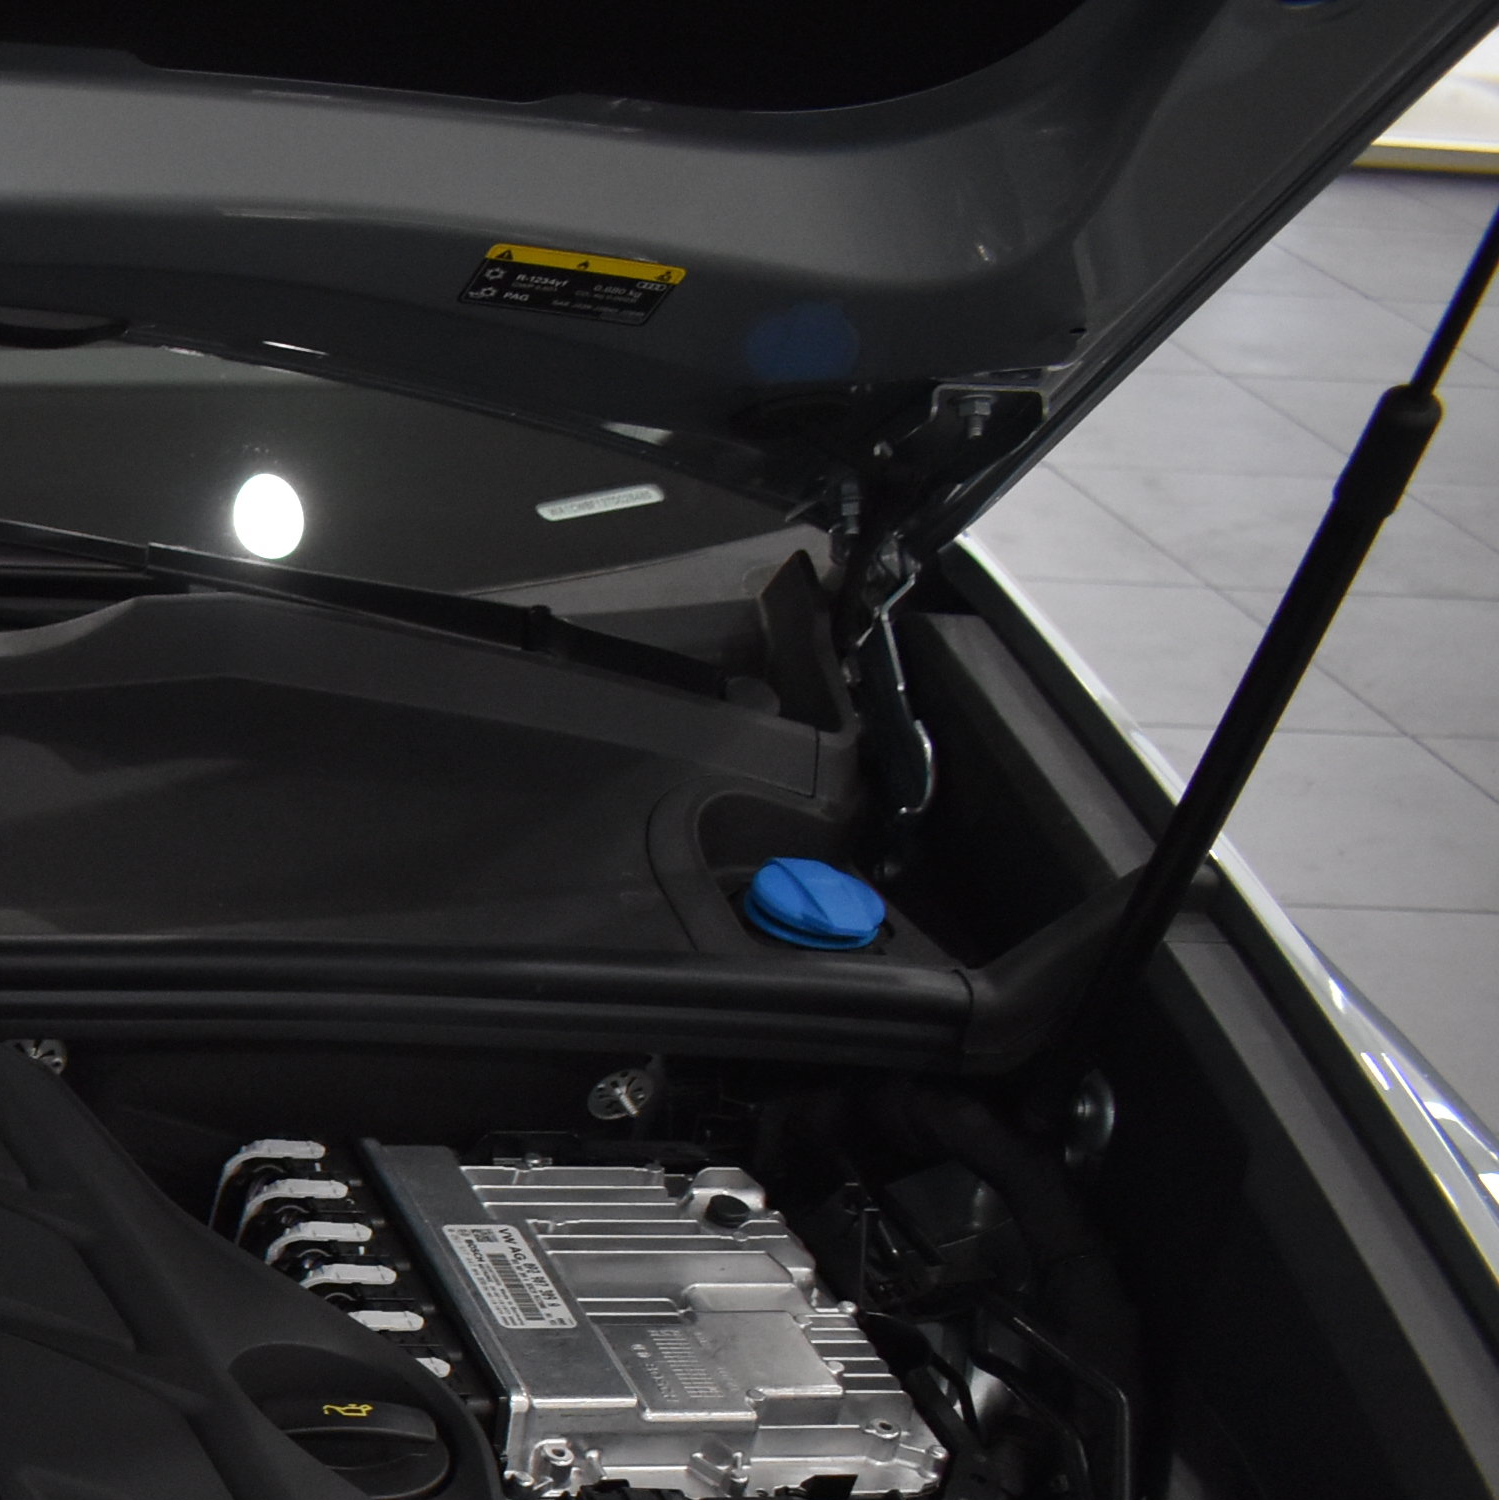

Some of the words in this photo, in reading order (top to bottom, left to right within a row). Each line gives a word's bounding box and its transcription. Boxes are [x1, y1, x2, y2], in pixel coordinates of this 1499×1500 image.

[503, 292, 530, 302] PAG
[464, 1239, 486, 1263] BOSCH
[498, 1227, 517, 1244] VW
[509, 1246, 527, 1261] AG
